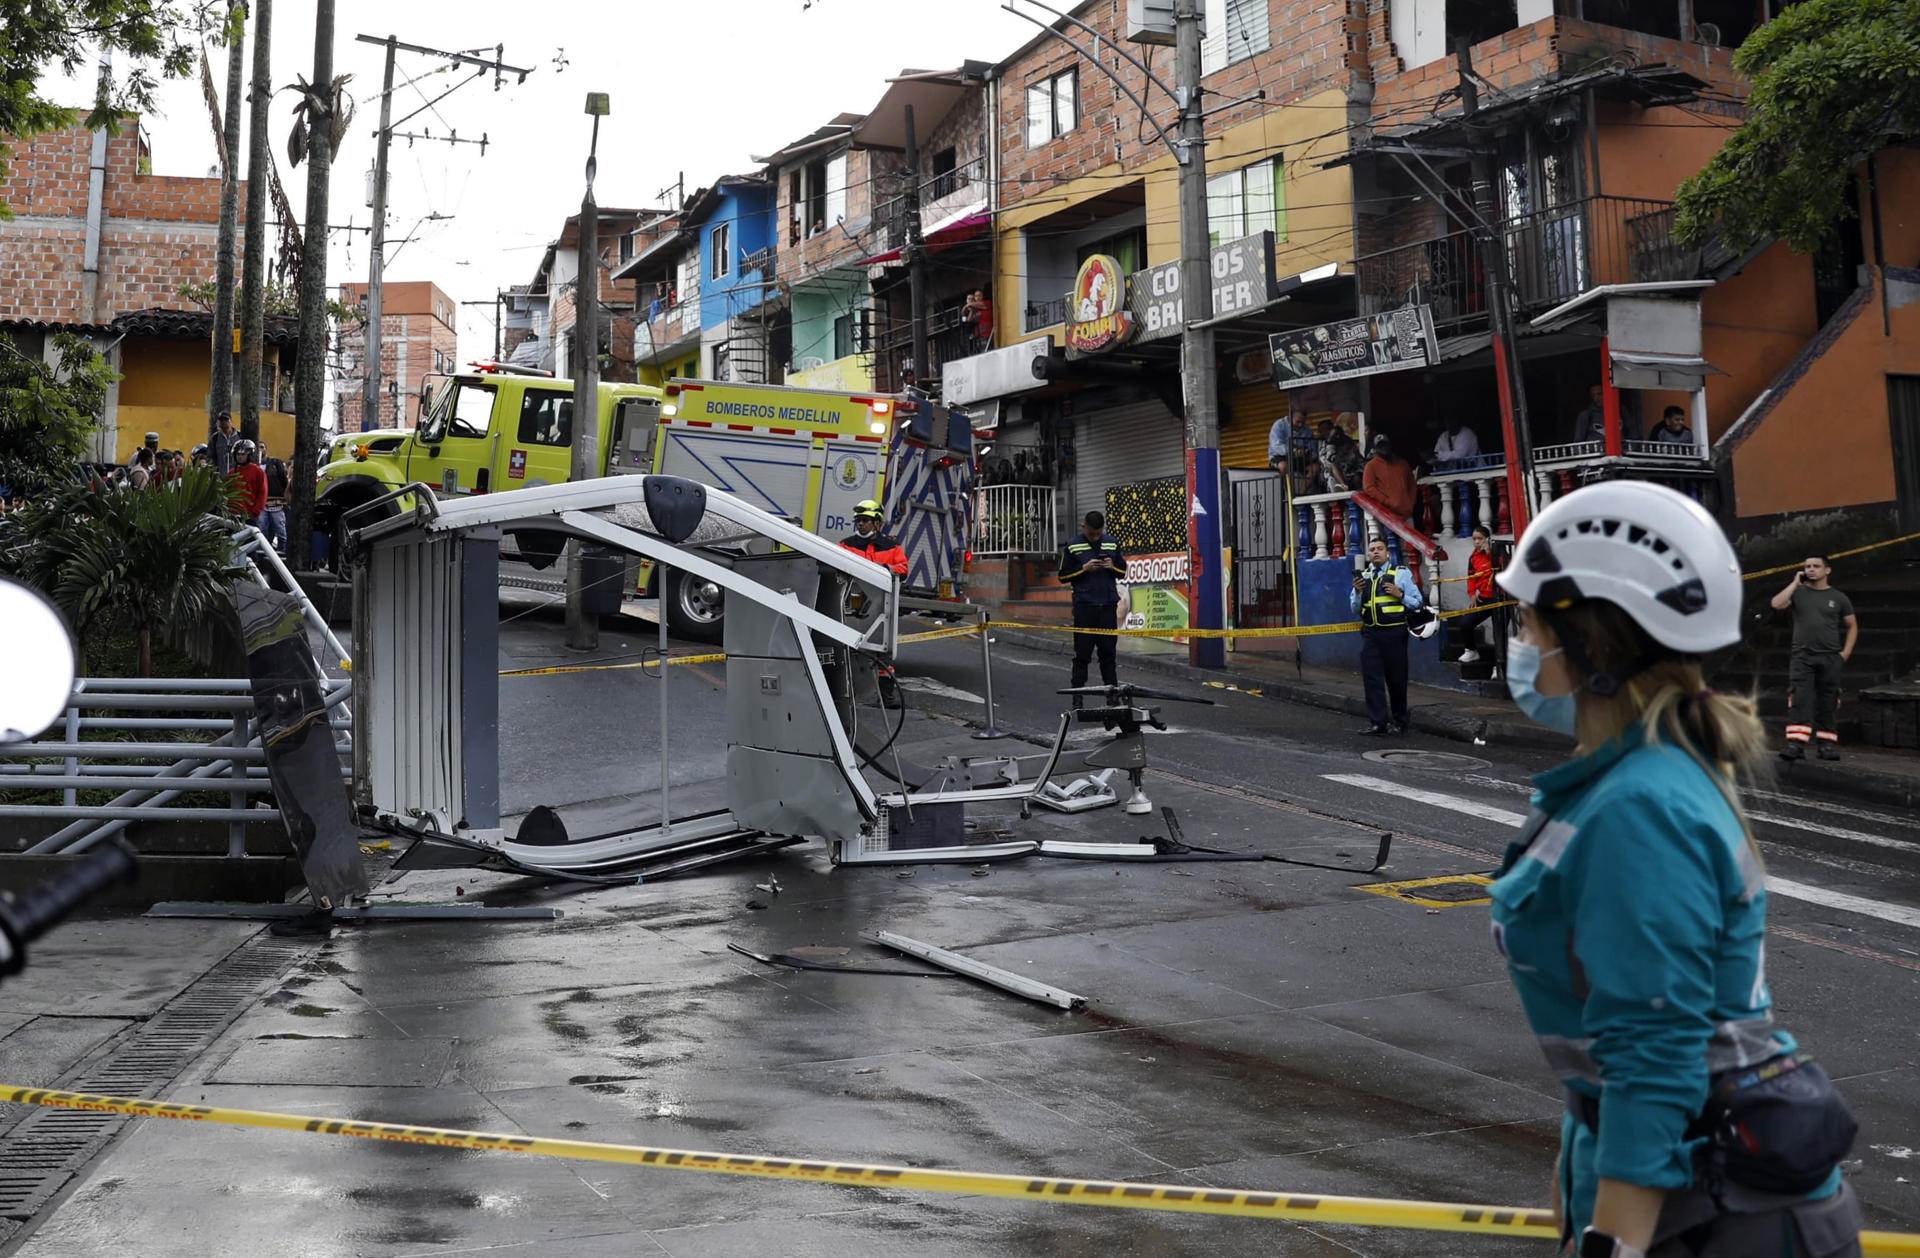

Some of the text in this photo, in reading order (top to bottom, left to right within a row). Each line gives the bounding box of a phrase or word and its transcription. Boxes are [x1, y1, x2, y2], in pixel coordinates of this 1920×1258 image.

[1152, 247, 1244, 297] COOS
[1147, 281, 1252, 332] BRTER
[706, 400, 841, 424] BOMBEROS MEDELLIN
[1127, 618, 1144, 627] MILO
